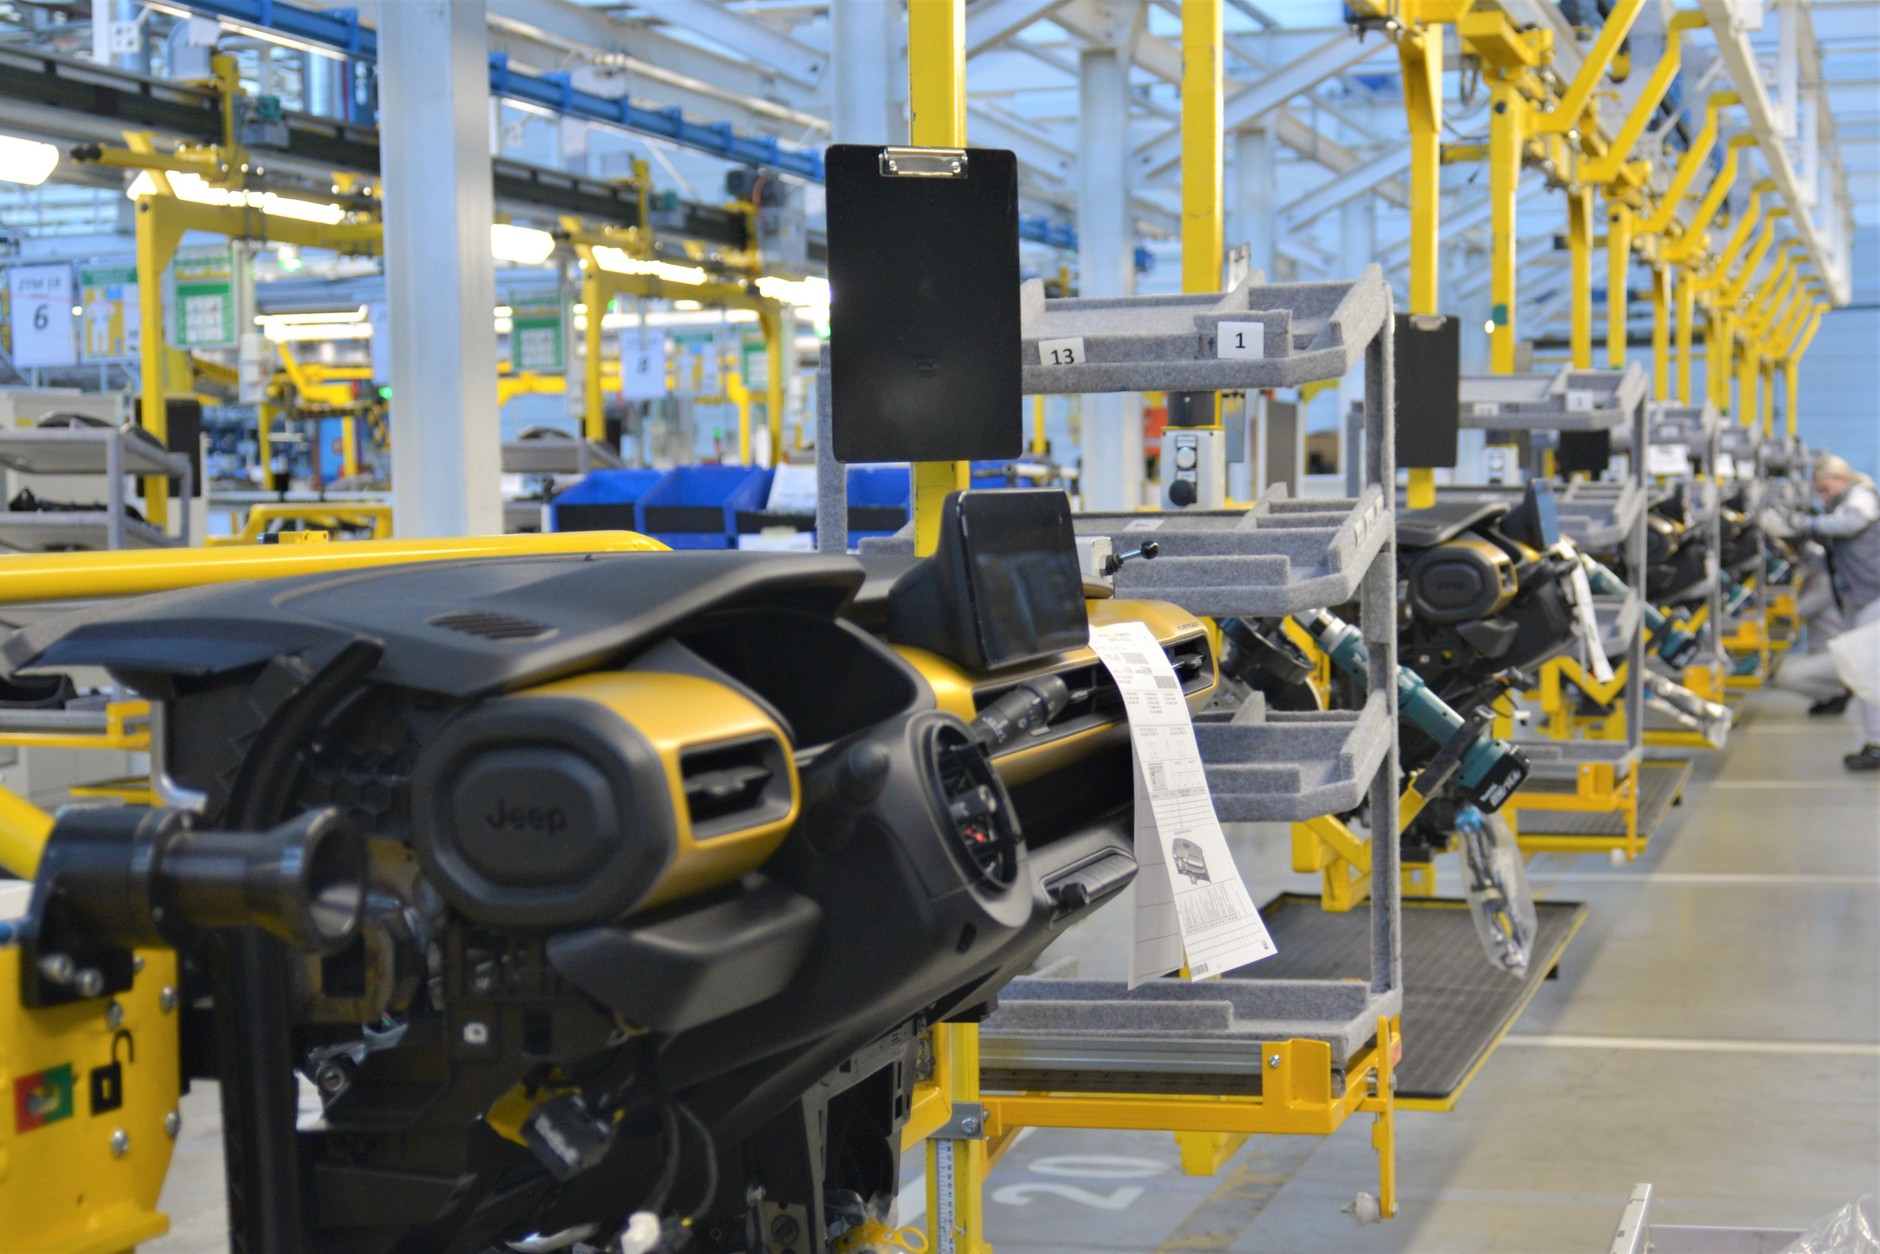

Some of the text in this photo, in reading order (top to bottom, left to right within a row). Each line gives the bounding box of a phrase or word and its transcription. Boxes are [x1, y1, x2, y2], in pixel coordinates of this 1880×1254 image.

[33, 302, 49, 331] 6
[1235, 332, 1246, 349] 1
[1050, 348, 1075, 365] 13
[485, 799, 565, 836] Jeep
[991, 1154, 1171, 1210] 20
